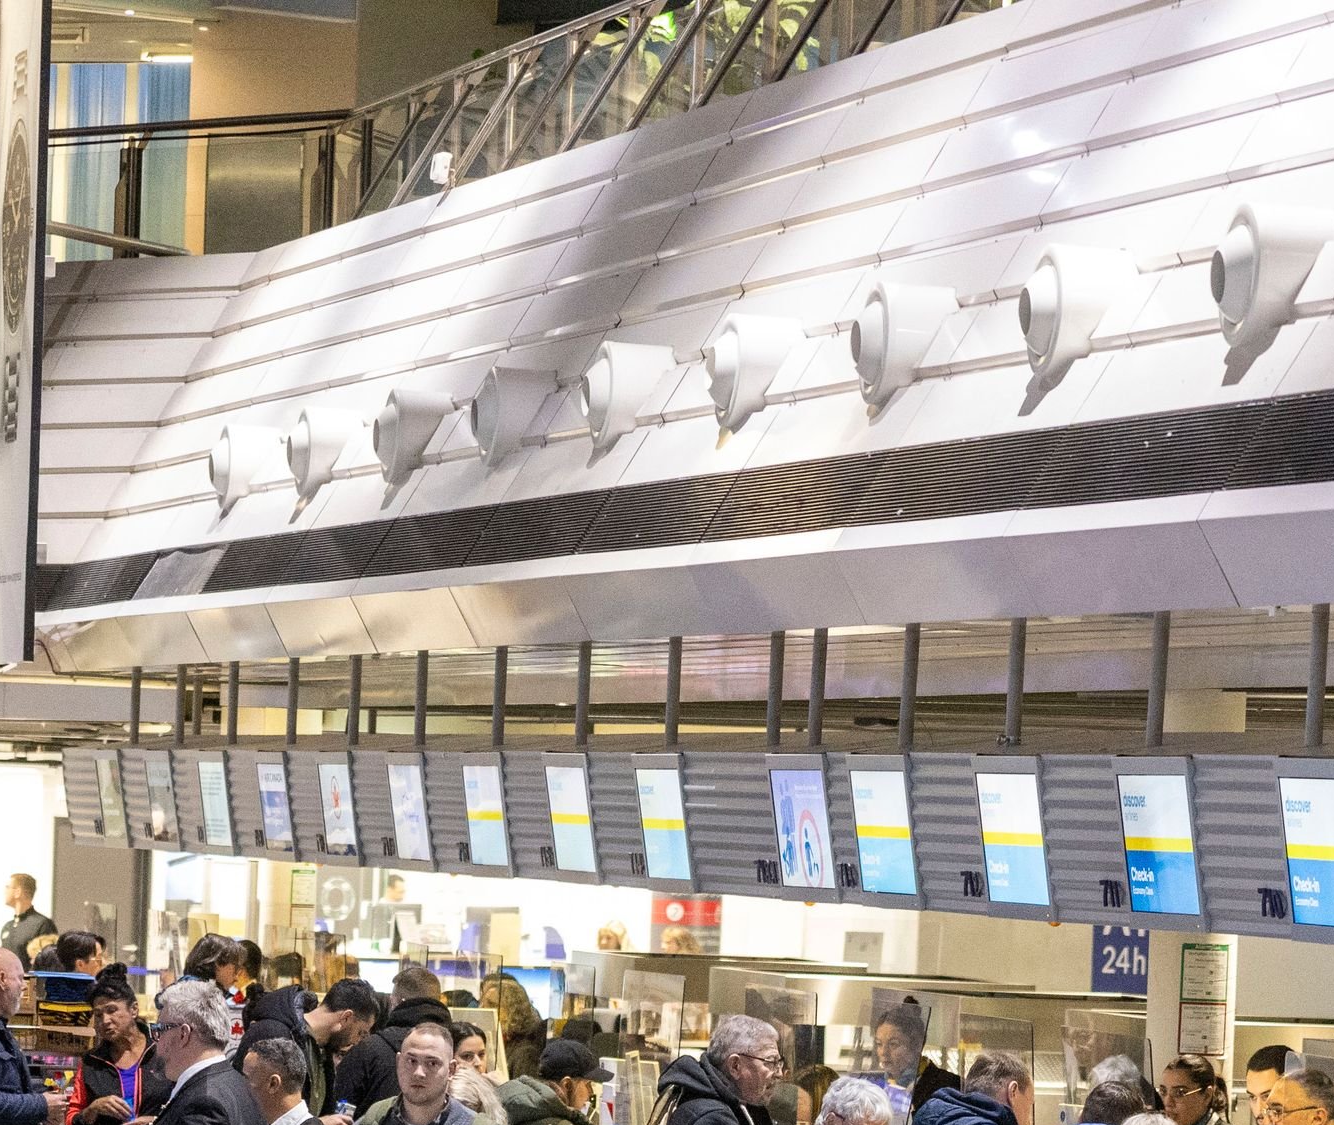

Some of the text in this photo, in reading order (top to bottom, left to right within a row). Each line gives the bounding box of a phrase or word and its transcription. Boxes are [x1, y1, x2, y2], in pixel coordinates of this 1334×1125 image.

[1131, 866, 1154, 882] Check-in
[1293, 876, 1320, 894] Check-in
[1101, 945, 1146, 976] 24h
